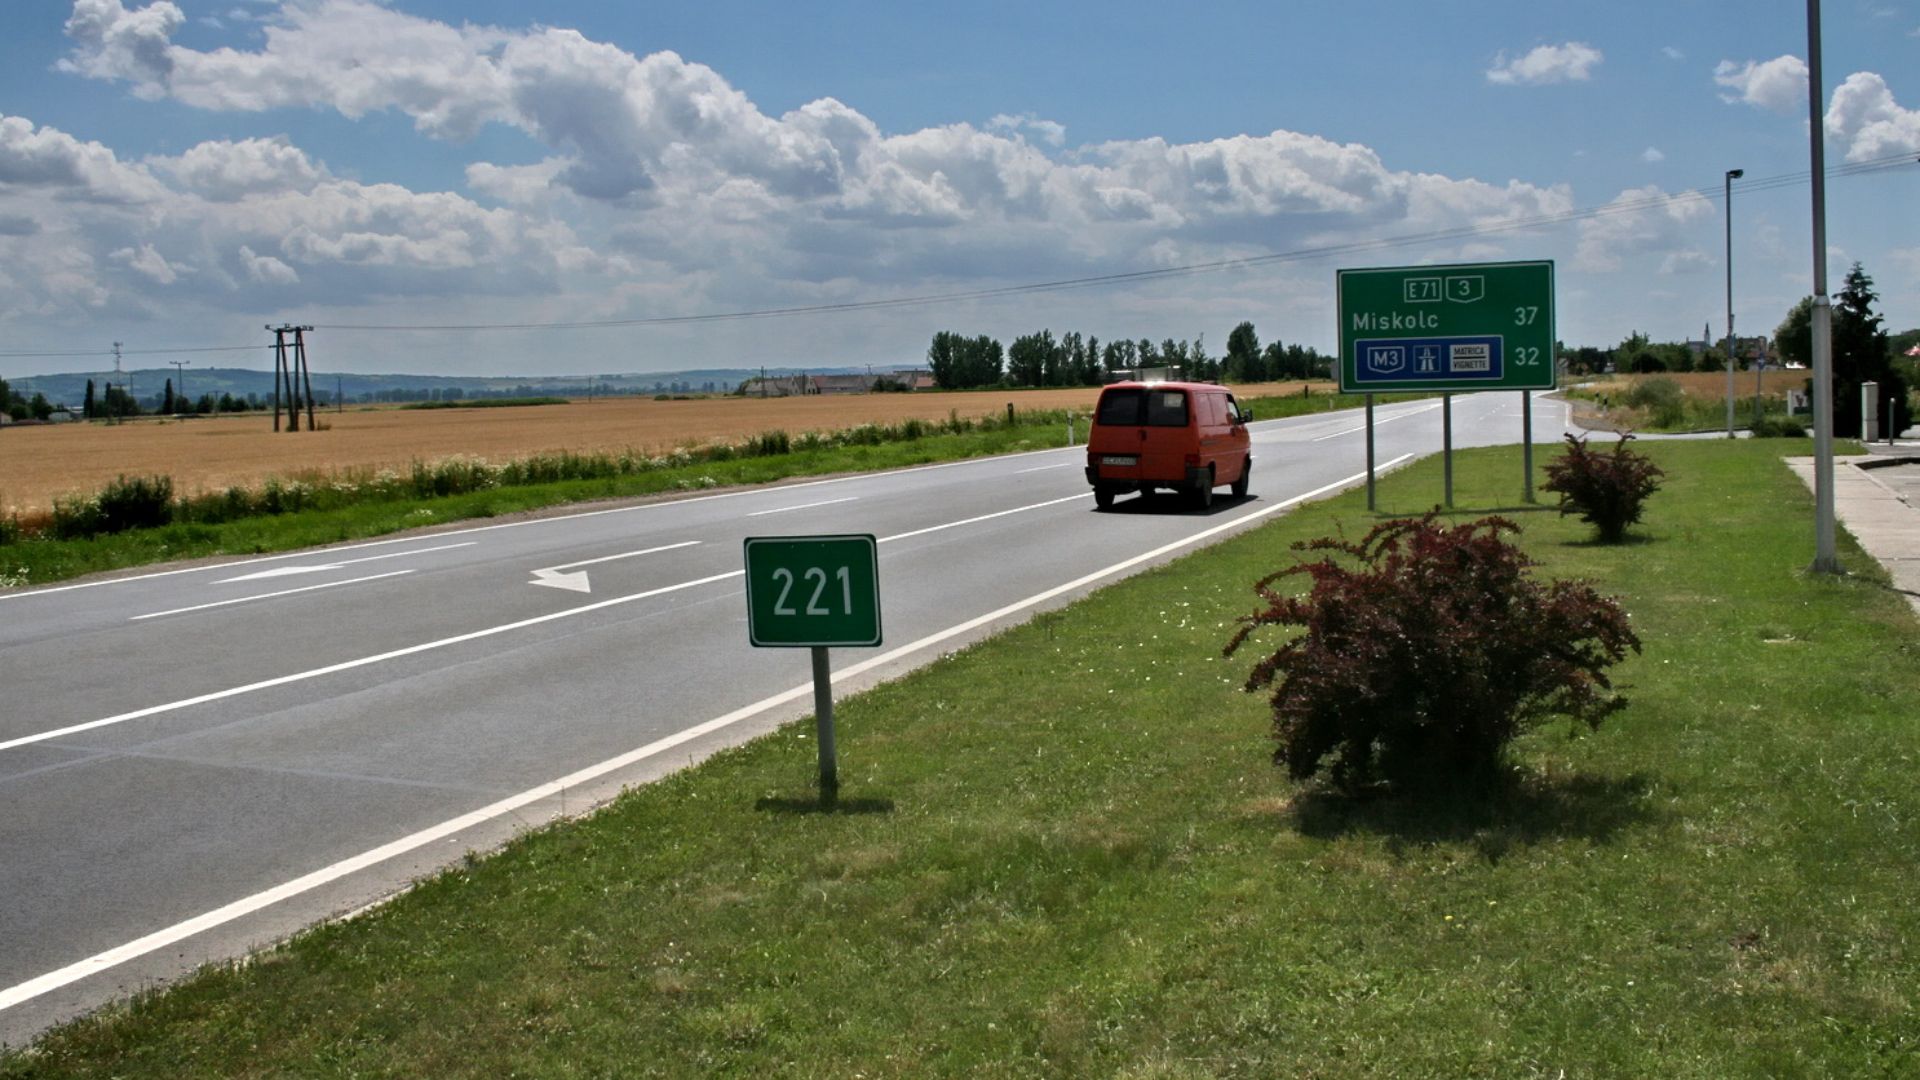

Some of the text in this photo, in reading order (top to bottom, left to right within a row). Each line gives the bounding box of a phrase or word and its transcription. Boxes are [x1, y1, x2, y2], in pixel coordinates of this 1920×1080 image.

[1458, 280, 1470, 296] 3
[1353, 306, 1538, 331] Miskolc 37
[1374, 350, 1398, 367] M3
[1454, 346, 1485, 355] MATRICA
[1515, 347, 1540, 366] 32
[1454, 359, 1487, 369] VIGNETTE
[772, 566, 852, 615] 221
